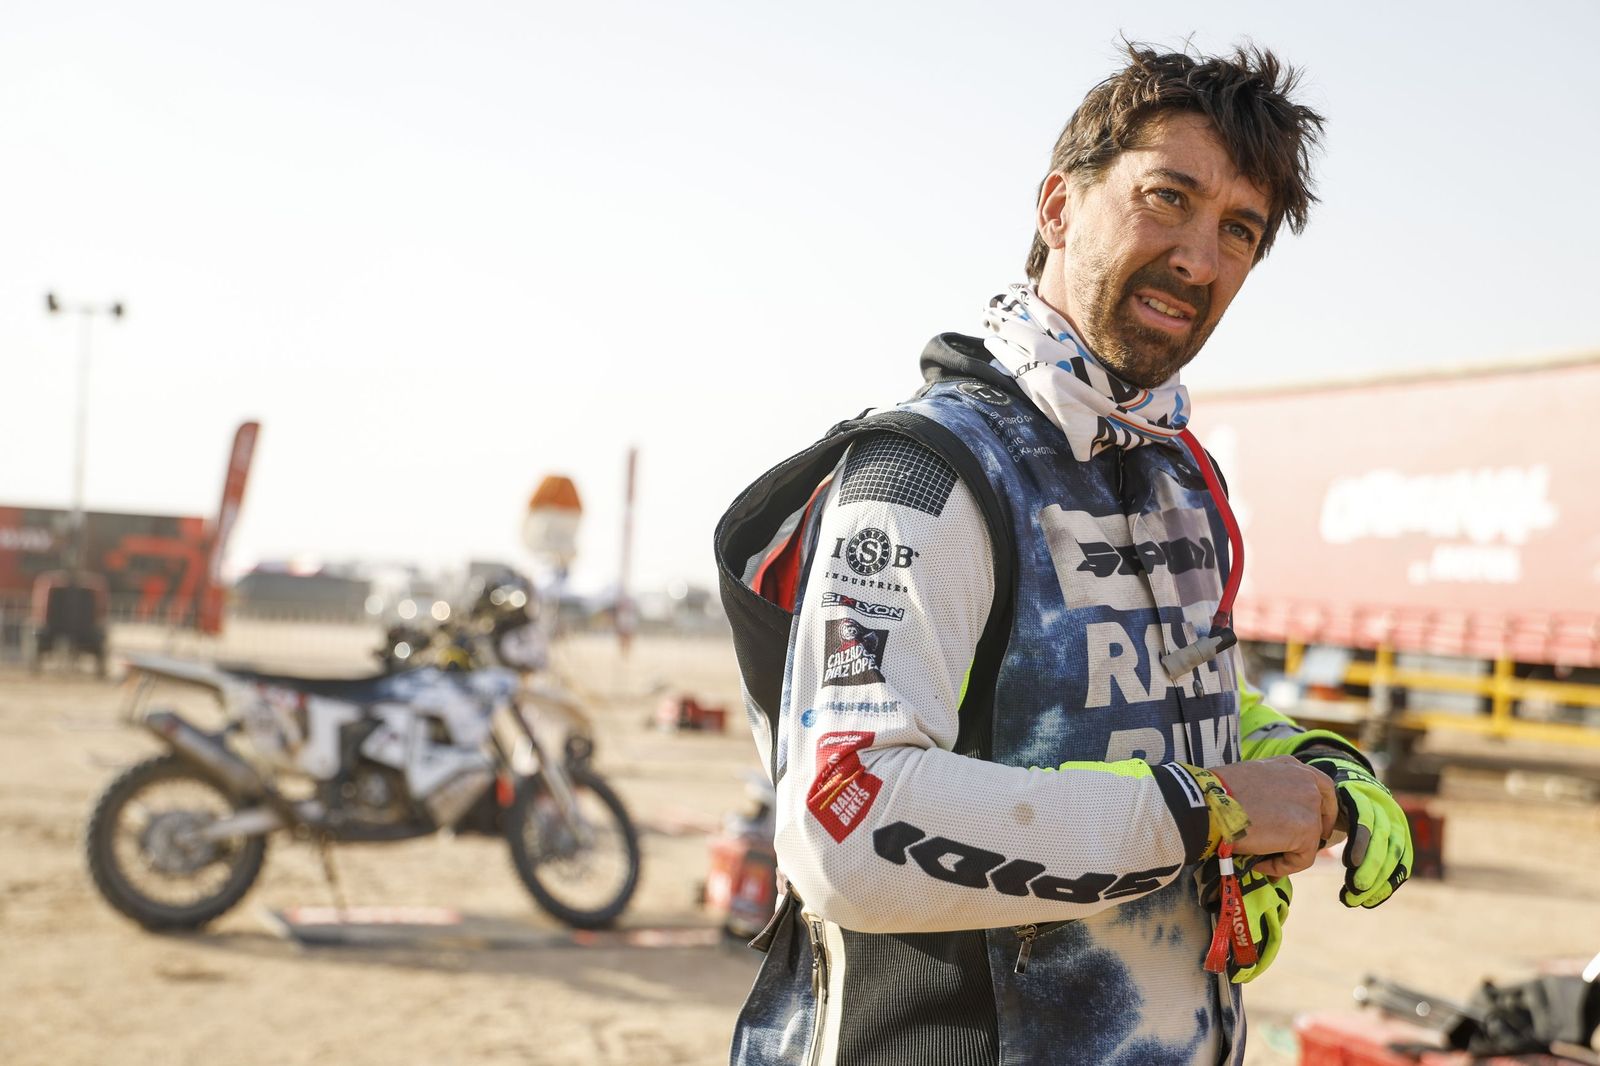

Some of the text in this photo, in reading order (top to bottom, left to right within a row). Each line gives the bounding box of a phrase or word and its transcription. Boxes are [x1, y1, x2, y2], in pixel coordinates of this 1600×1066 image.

[825, 571, 909, 593] INDUSTRIES
[829, 779, 861, 816] RALLY
[838, 787, 871, 827] BIKES
